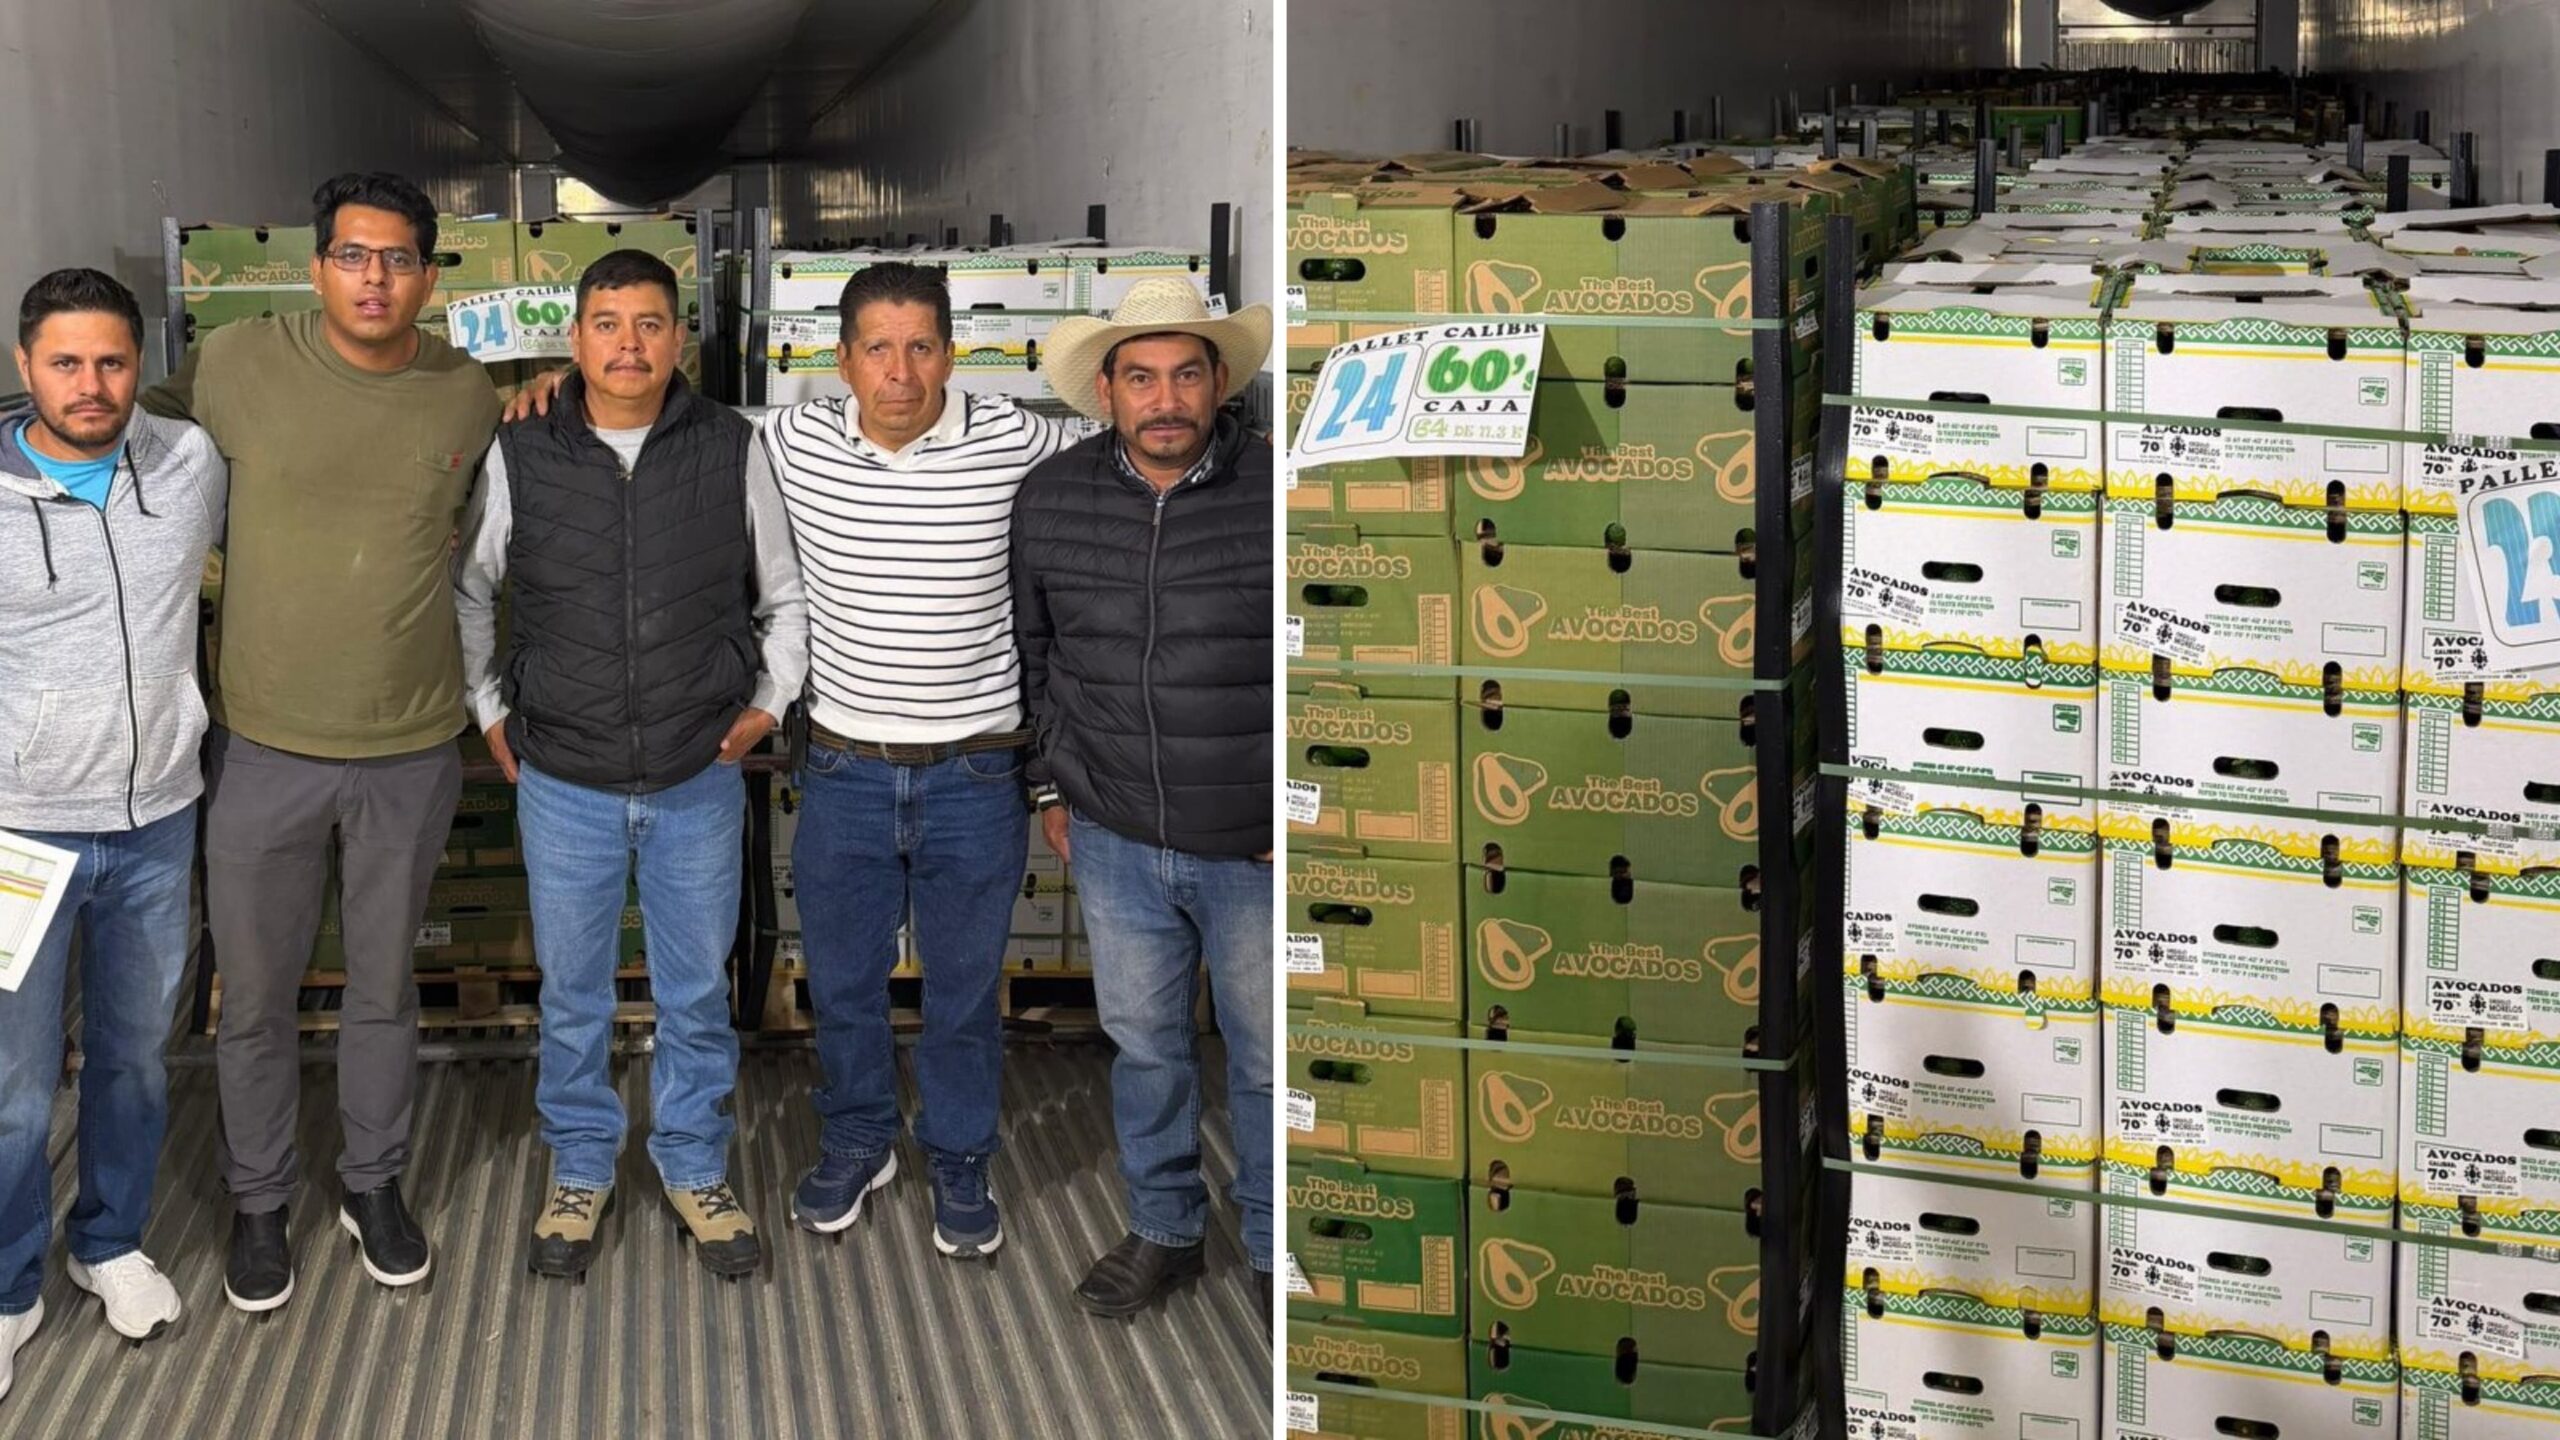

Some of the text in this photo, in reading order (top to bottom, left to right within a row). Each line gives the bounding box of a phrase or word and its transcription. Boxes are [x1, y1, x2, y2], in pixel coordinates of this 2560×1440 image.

[1287, 229, 1407, 251] VOCADOS
[1582, 278, 1654, 291] The Best
[449, 293, 507, 311] PALLET
[1544, 290, 1692, 313] AVOCADOS
[460, 304, 508, 352] 24
[1331, 330, 1429, 358] PALLET
[1315, 351, 1408, 442] 24
[1424, 400, 1519, 412] CAJA
[1854, 405, 1934, 424] AVOCADOS
[1413, 418, 1448, 438] 64
[1454, 425, 1474, 438] DE
[1616, 444, 1654, 458] Best
[2425, 443, 2517, 460] AVOCADOS
[1544, 458, 1692, 481] AVOCADOS
[2460, 461, 2560, 494] PALLE
[1287, 557, 1410, 578] VOCADOS
[1850, 567, 1928, 596] AVOCADOS
[1587, 605, 1659, 619] The Best
[2126, 601, 2210, 634] AVOCADOS
[1549, 617, 1697, 643] AVOCADOS
[2432, 637, 2483, 647] AVOC
[1287, 718, 1411, 743] VOCADOS
[1287, 781, 1317, 792] ADOS
[1587, 776, 1660, 791] The Best
[2109, 771, 2194, 788] AVOCADOS
[1550, 787, 1698, 816] AVOCADOS
[2430, 803, 2521, 823] AVOCADOS
[1287, 874, 1414, 904] VOCADOS
[1845, 912, 1893, 922] CADOS
[1287, 935, 1319, 943] ADOS
[2113, 929, 2198, 944] AVOCADOS
[1591, 943, 1662, 958] The Best
[1553, 953, 1701, 982] AVOCADOS
[2432, 980, 2523, 994] AVOCADOS
[1287, 1033, 1413, 1062] VOCADOS
[1846, 1069, 1910, 1089] OCADOS
[1592, 1097, 1664, 1114] The Best
[2120, 1100, 2203, 1114] AVOCADOS
[1555, 1106, 1702, 1138] AVOCADOS
[2427, 1149, 2517, 1165] AVOCADOS
[1287, 1186, 1414, 1218] VOCADOS
[1847, 1218, 1911, 1232] OCADOS
[2112, 1247, 2196, 1273] AVOCADOS
[1594, 1265, 1666, 1286] The Best
[1557, 1275, 1704, 1309] AVOCADOS
[2432, 1296, 2511, 1319] AVOCAD
[1848, 1407, 1916, 1423] VOCADOS
